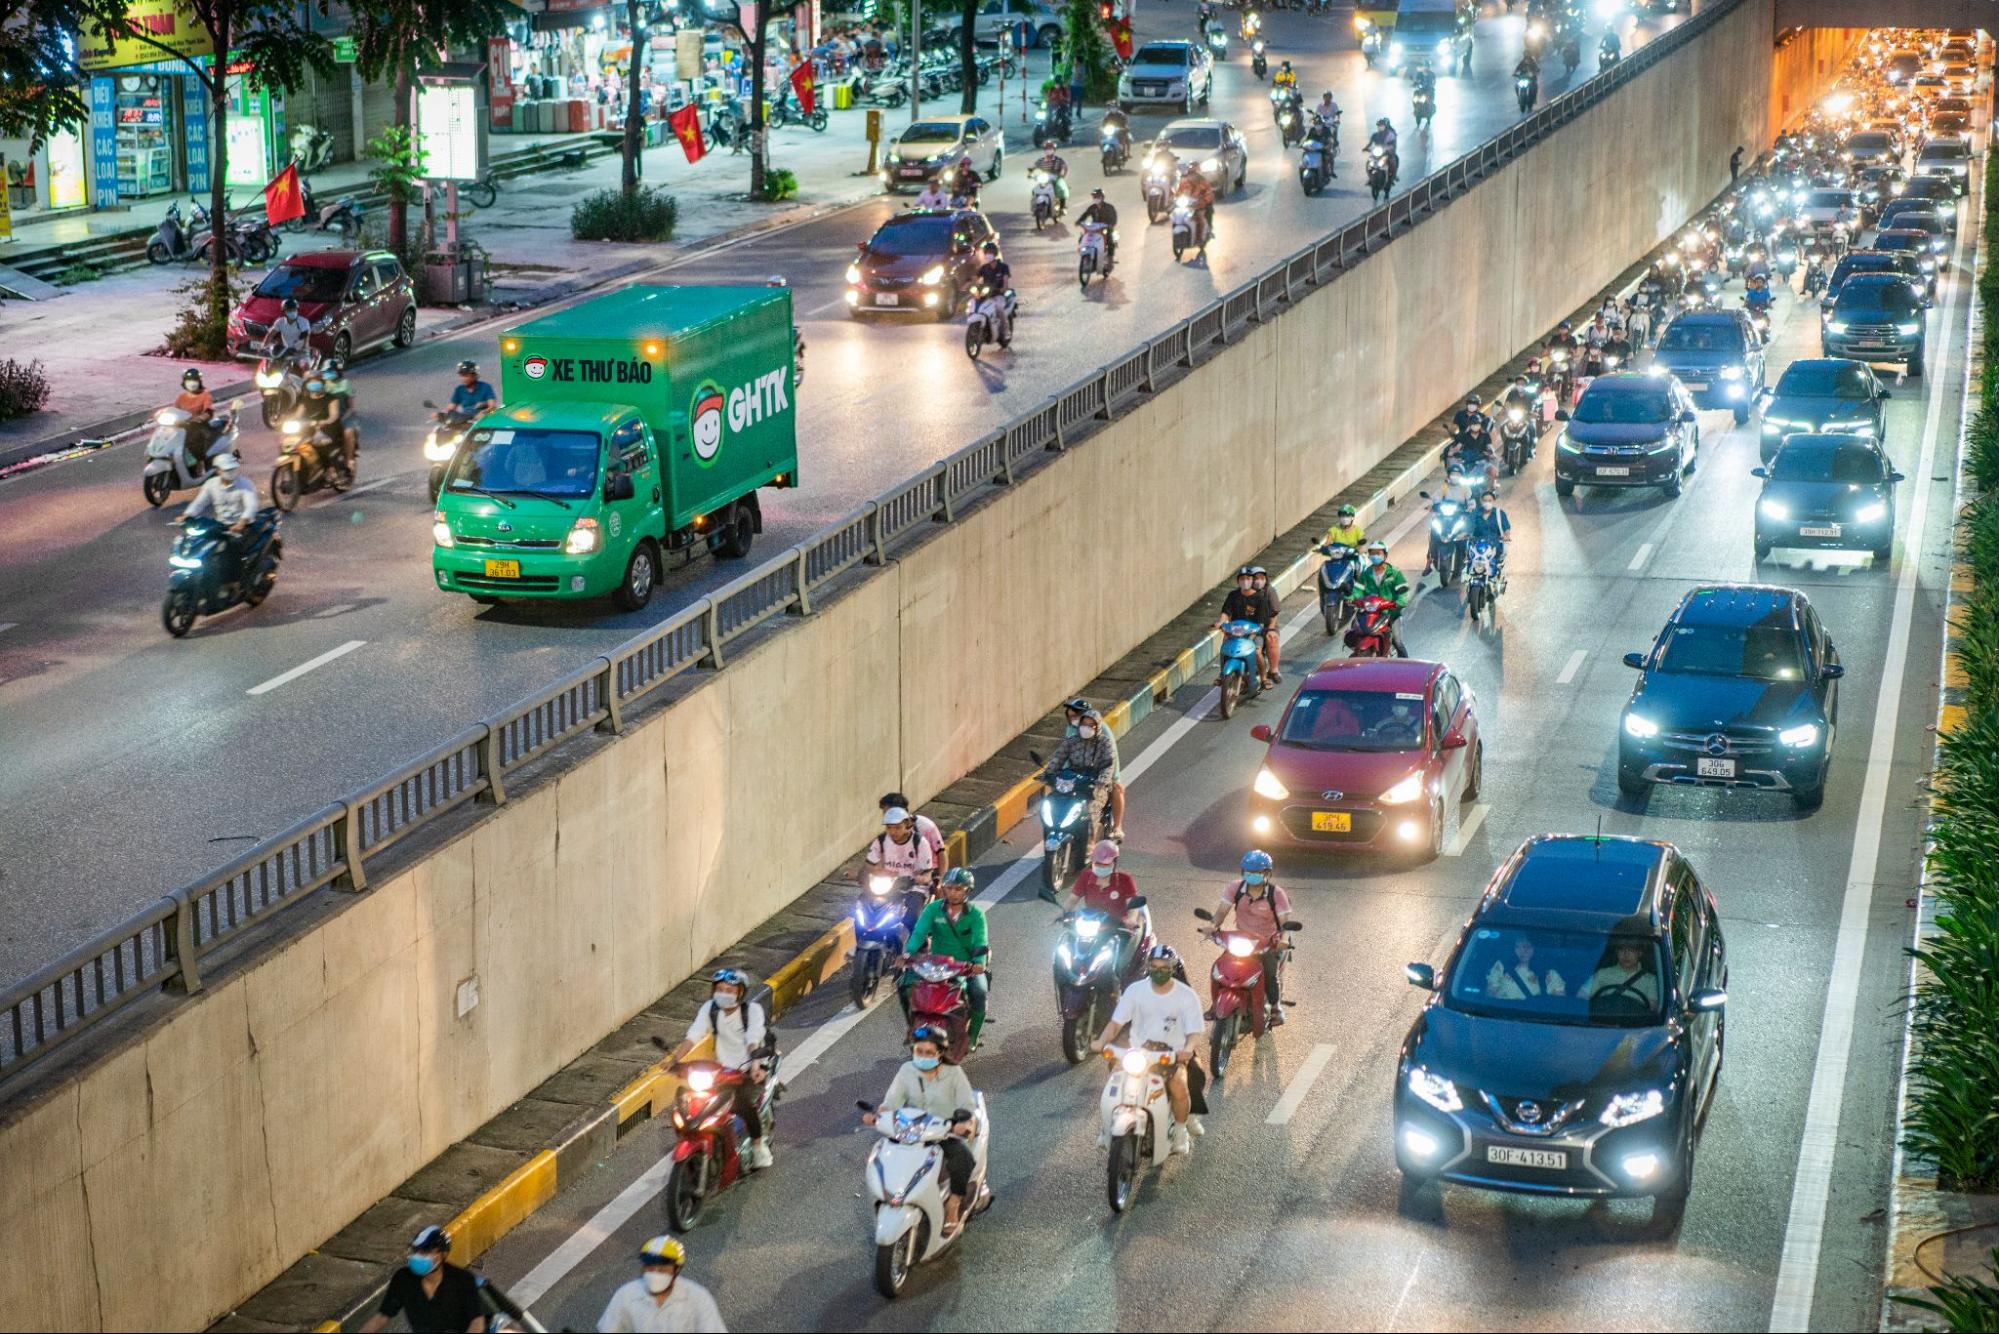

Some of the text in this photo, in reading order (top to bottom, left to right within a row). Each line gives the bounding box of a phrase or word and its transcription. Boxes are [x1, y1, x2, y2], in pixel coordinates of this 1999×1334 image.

[187, 122, 203, 142] CÁC
[96, 136, 113, 156] CÁC
[188, 173, 207, 190] PIN
[97, 188, 117, 207] PIN
[551, 356, 652, 384] XE THƯ BÁO
[727, 365, 789, 433] GHTK
